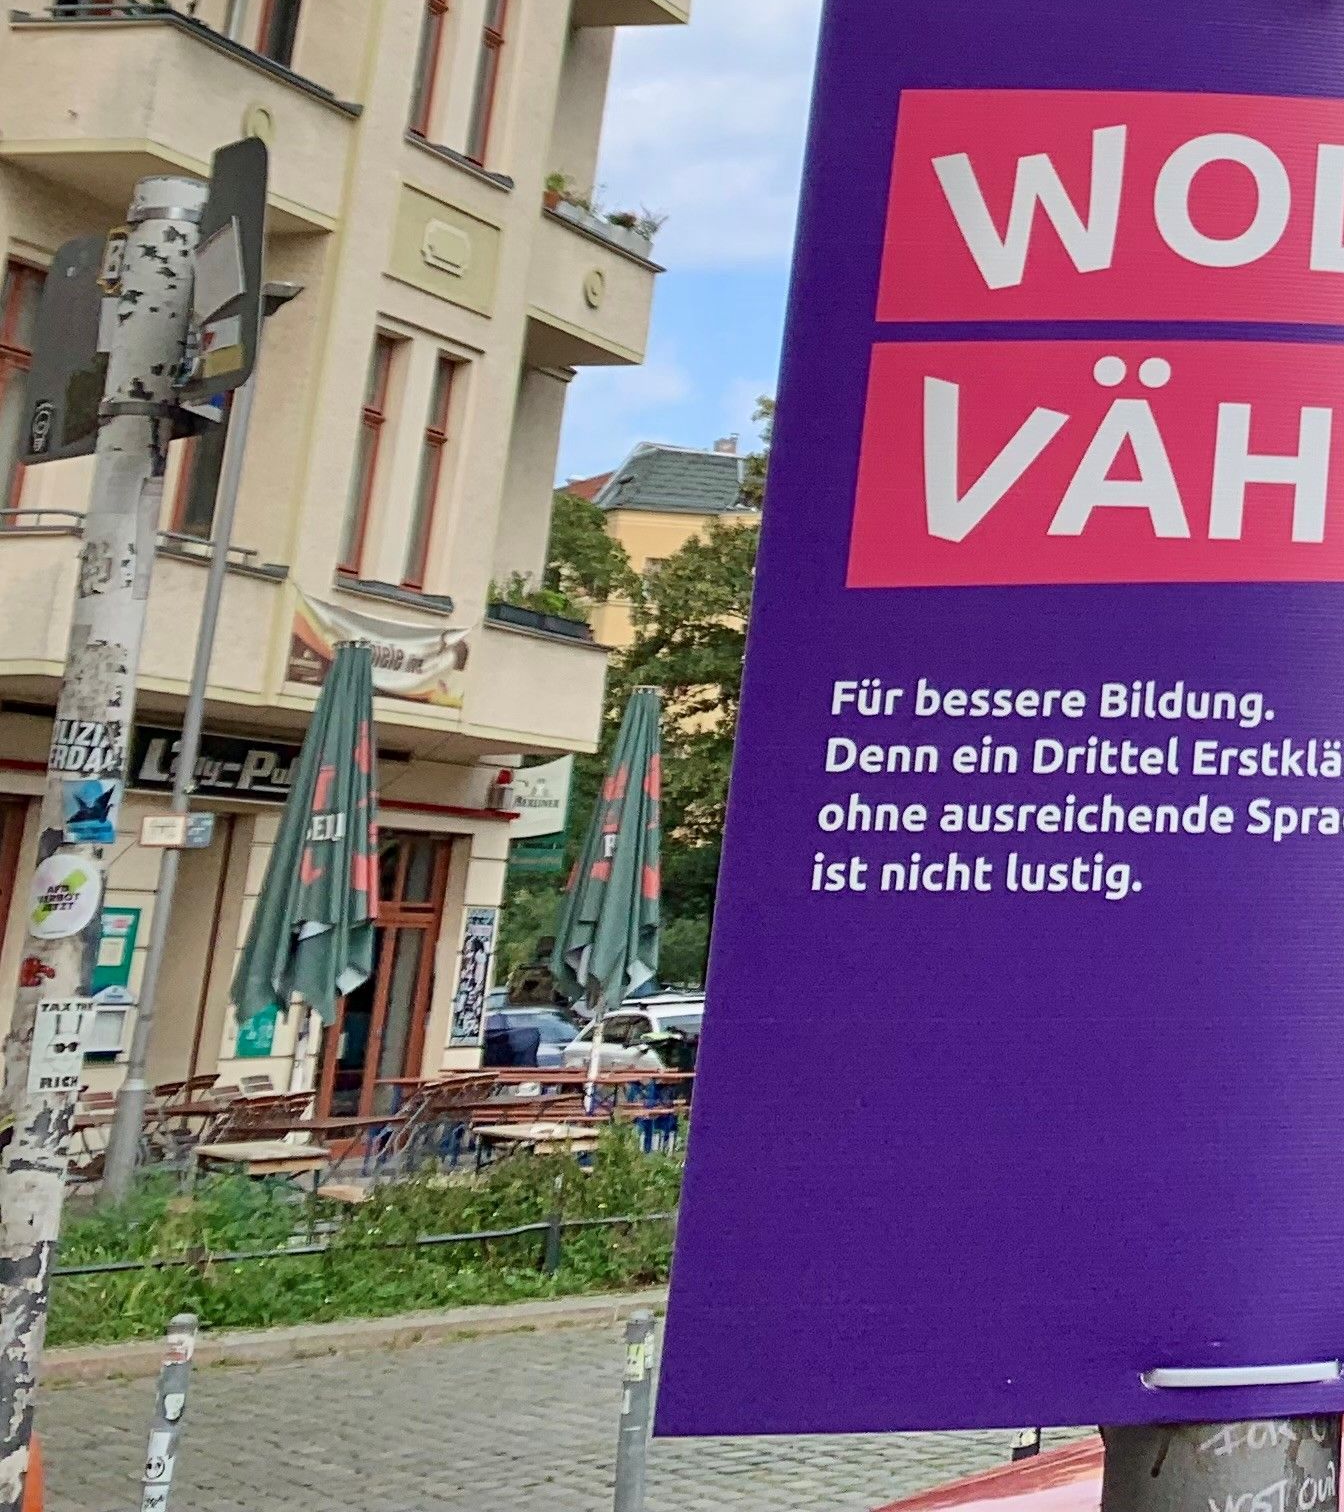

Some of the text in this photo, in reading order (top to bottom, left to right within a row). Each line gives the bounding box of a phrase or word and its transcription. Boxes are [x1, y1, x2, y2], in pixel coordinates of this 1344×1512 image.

[831, 678, 1275, 728] Für bessere Bildung.
[825, 737, 939, 773] Denn
[952, 735, 1018, 774] ein
[1032, 735, 1179, 775] Drittel
[818, 792, 927, 832] ohne
[940, 793, 1234, 834] ausreichende
[811, 852, 1143, 900] ist nicht lustig.
[41, 1002, 71, 1013] TAX
[40, 1076, 79, 1090] RICH
